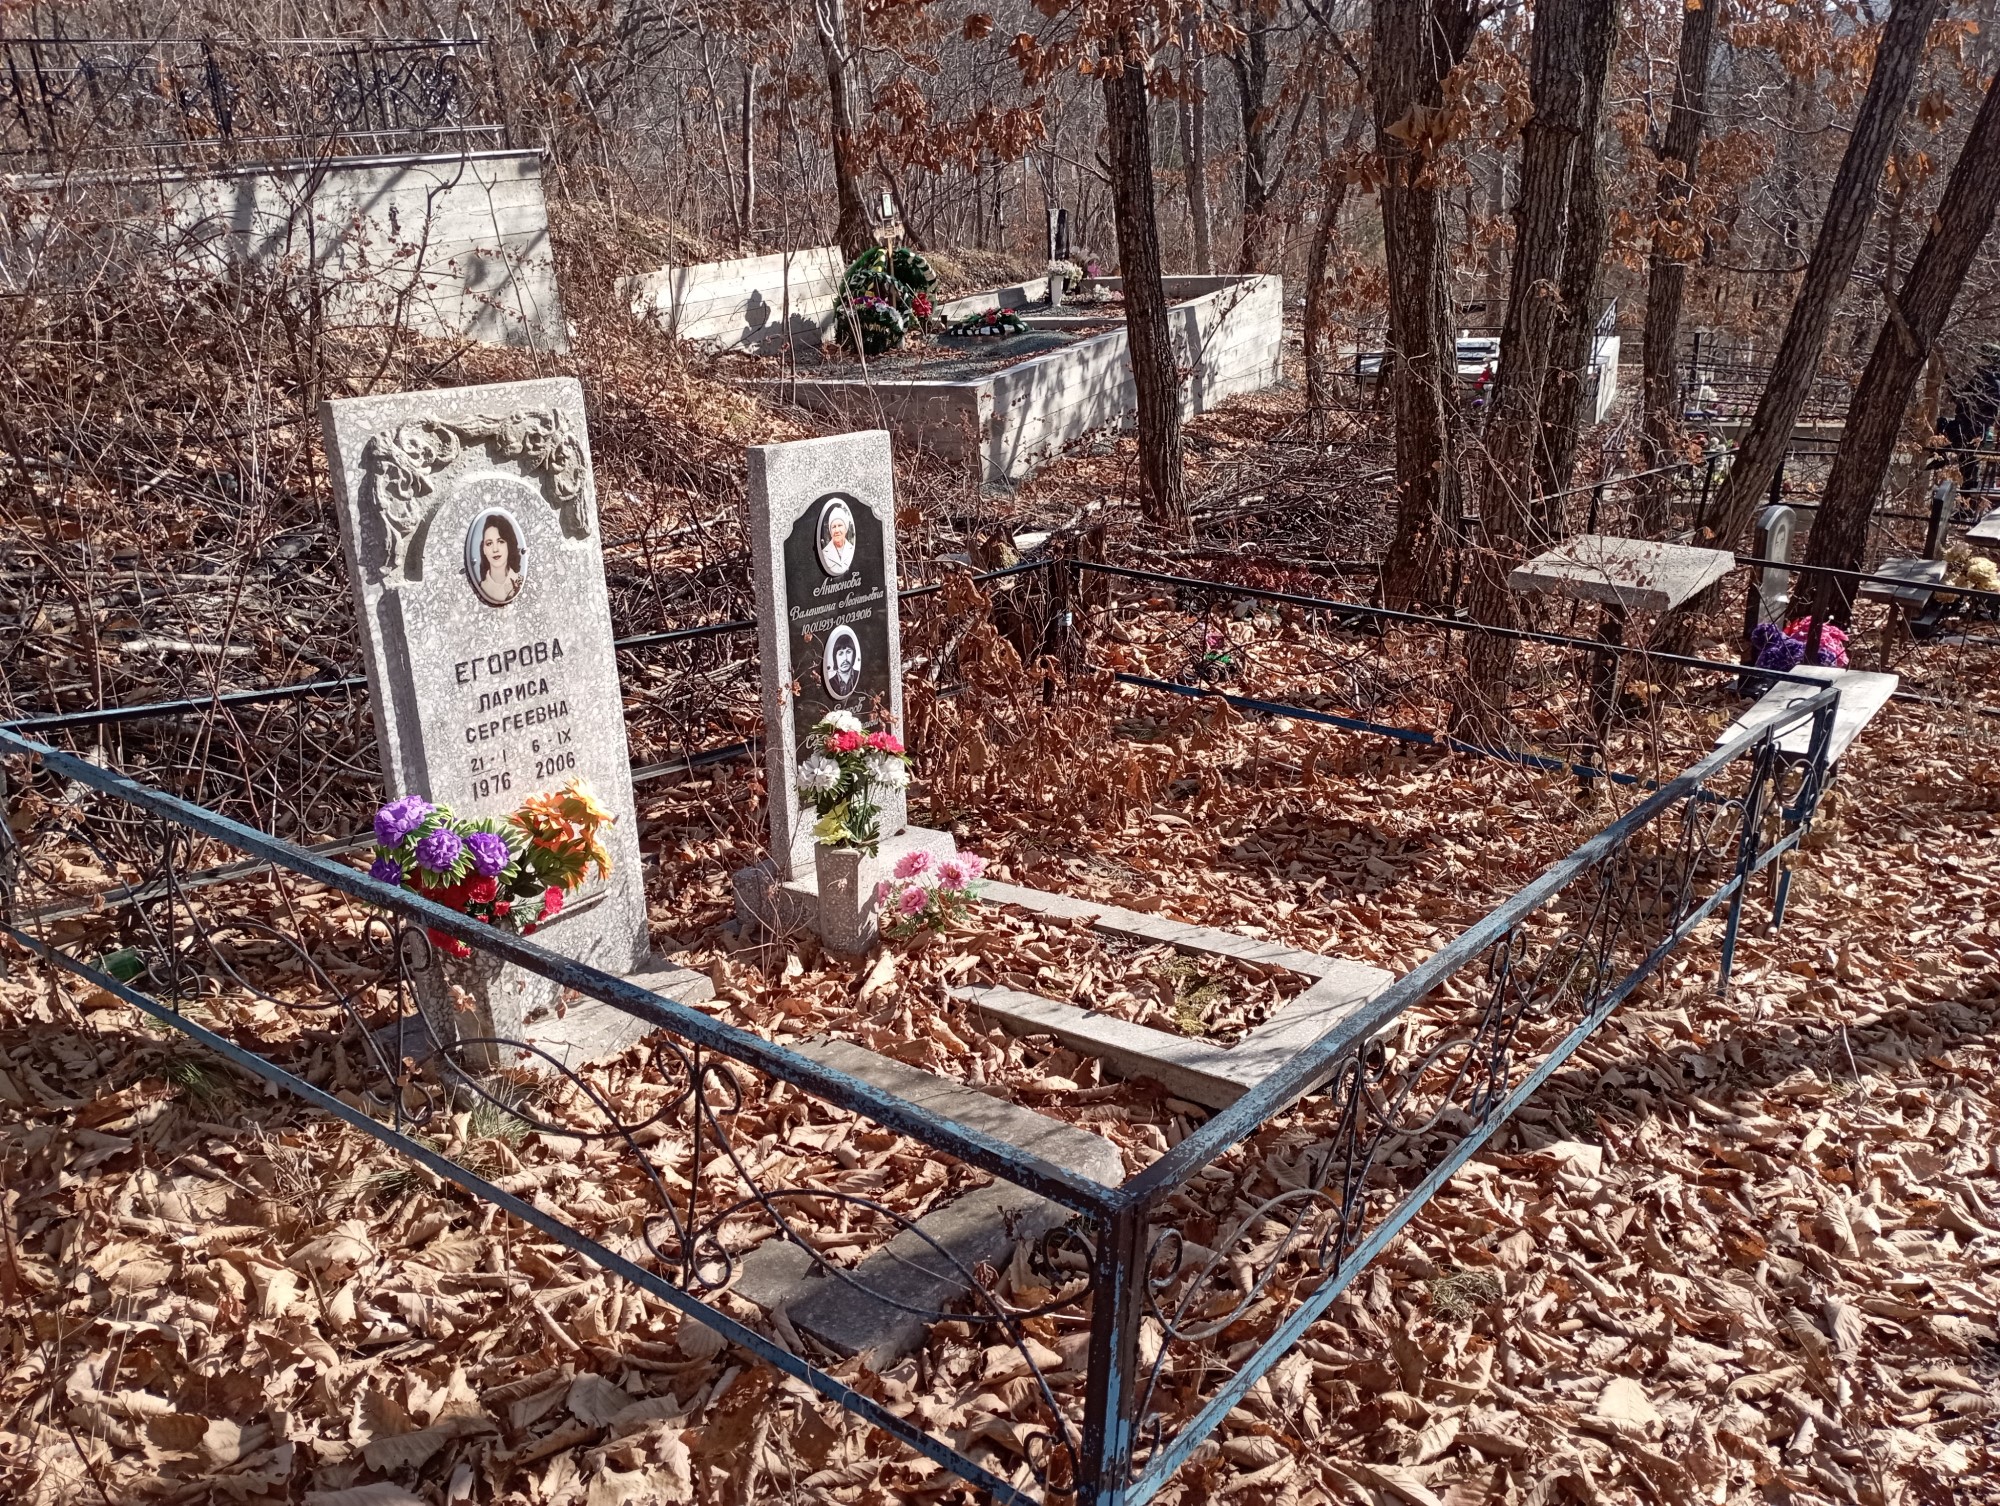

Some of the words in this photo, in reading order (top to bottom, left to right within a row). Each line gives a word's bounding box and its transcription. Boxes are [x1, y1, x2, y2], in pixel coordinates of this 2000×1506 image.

[790, 602, 836, 621] Валентина
[455, 638, 563, 685] ЕГОРОВА
[478, 678, 549, 713] ЛАРИСА
[466, 700, 569, 743] СЕРГЕЕВНА
[536, 751, 576, 779] 2006
[472, 771, 511, 801] 1976
